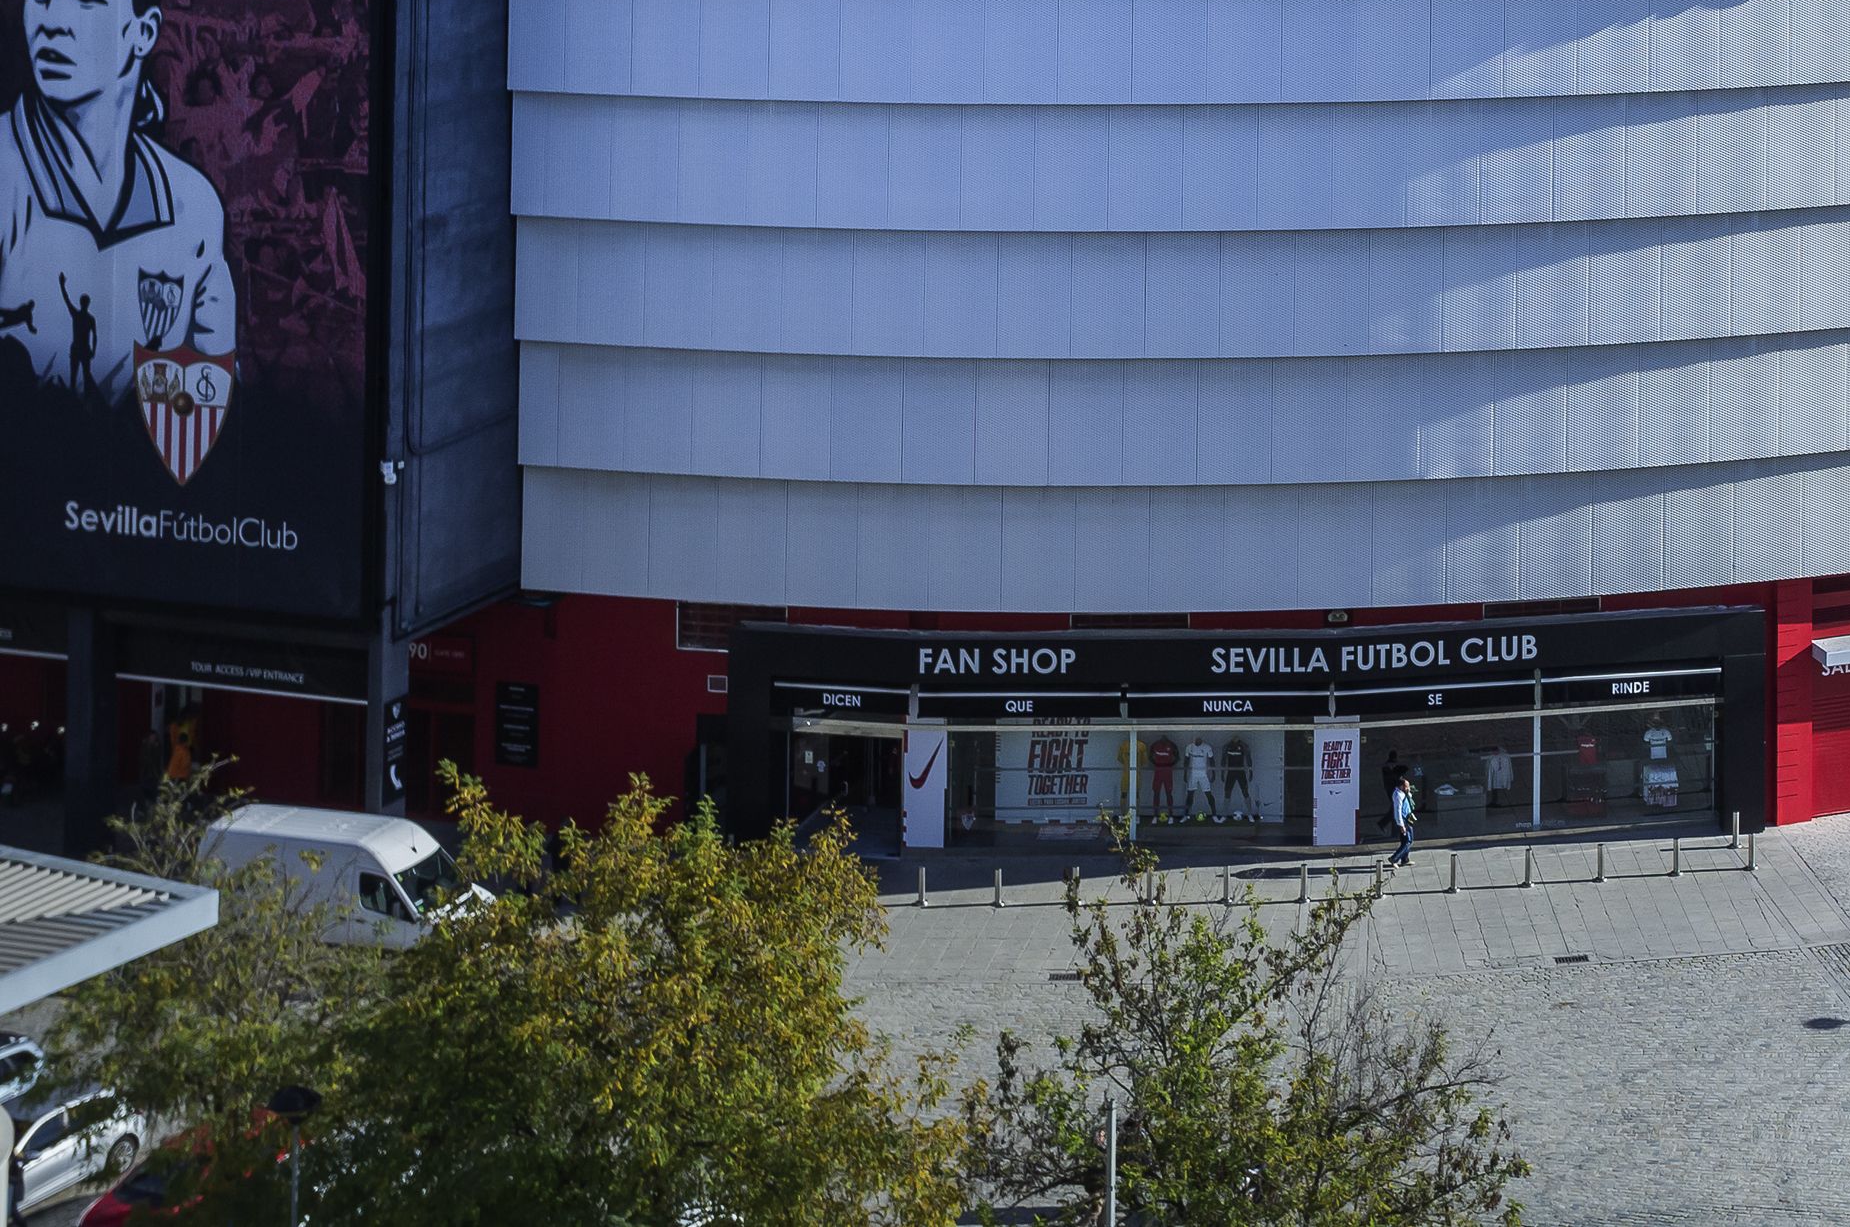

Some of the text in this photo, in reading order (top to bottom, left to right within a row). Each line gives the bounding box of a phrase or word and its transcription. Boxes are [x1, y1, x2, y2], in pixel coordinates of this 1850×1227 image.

[918, 647, 1077, 675] FAN SHOP
[1210, 634, 1539, 674] SEVILLA FUTBOL CLUB
[190, 661, 212, 673] TOUR
[215, 664, 244, 677] ACCESS
[263, 669, 305, 684] ENTRANCE
[822, 680, 1651, 714] DICEN QUE NUNCA SE RINDE
[1027, 739, 1088, 774] FIGHT
[1323, 740, 1353, 752] READY TO
[1321, 752, 1351, 769] FIGHT
[1028, 774, 1089, 795] TOGETHER
[1321, 769, 1351, 780] TOGETHER
